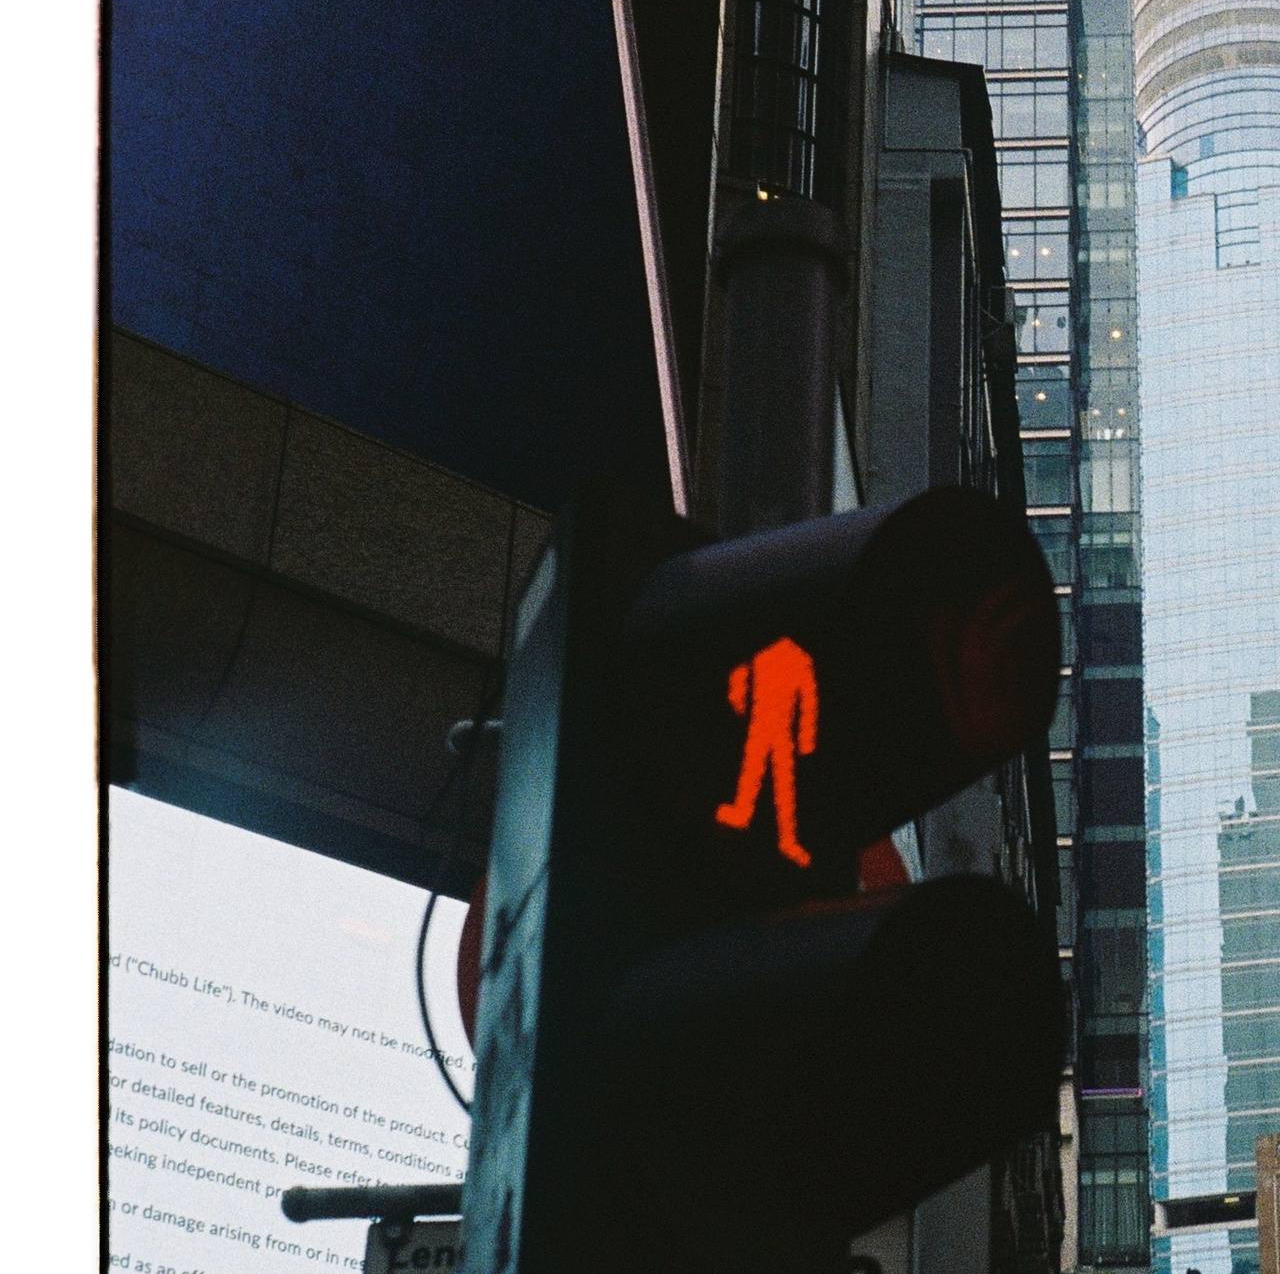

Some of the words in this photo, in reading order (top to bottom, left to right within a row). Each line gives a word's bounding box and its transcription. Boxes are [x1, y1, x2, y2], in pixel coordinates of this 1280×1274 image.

[241, 991, 269, 1012] The
[274, 1003, 313, 1025] video
[318, 1017, 349, 1037] may
[352, 1027, 376, 1044] not
[380, 1033, 398, 1049] be
[109, 1074, 127, 1088] or
[131, 1079, 195, 1108] detailed
[200, 1097, 266, 1129] features,
[271, 1117, 323, 1144] details,
[328, 1132, 372, 1158] terms,
[377, 1148, 451, 1176] conditions
[161, 1054, 176, 1069] to
[181, 1061, 207, 1077] sell
[211, 1070, 228, 1083] or
[232, 1075, 257, 1092] the
[261, 1084, 339, 1114] promotion
[343, 1106, 358, 1119] of
[362, 1110, 386, 1127] the
[390, 1119, 448, 1145] product.
[115, 1108, 133, 1126] its
[139, 1118, 186, 1142] policy
[190, 1129, 279, 1165] documents.
[285, 1153, 332, 1177] Please
[336, 1170, 371, 1187] refer
[162, 1154, 260, 1194] independent
[109, 1253, 131, 1269] ed
[135, 1260, 152, 1274] as
[121, 1202, 139, 1215] or
[142, 1205, 205, 1234] damage
[209, 1224, 261, 1250] arising
[266, 1234, 301, 1256] from
[306, 1247, 322, 1260] or
[326, 1248, 339, 1265] in
